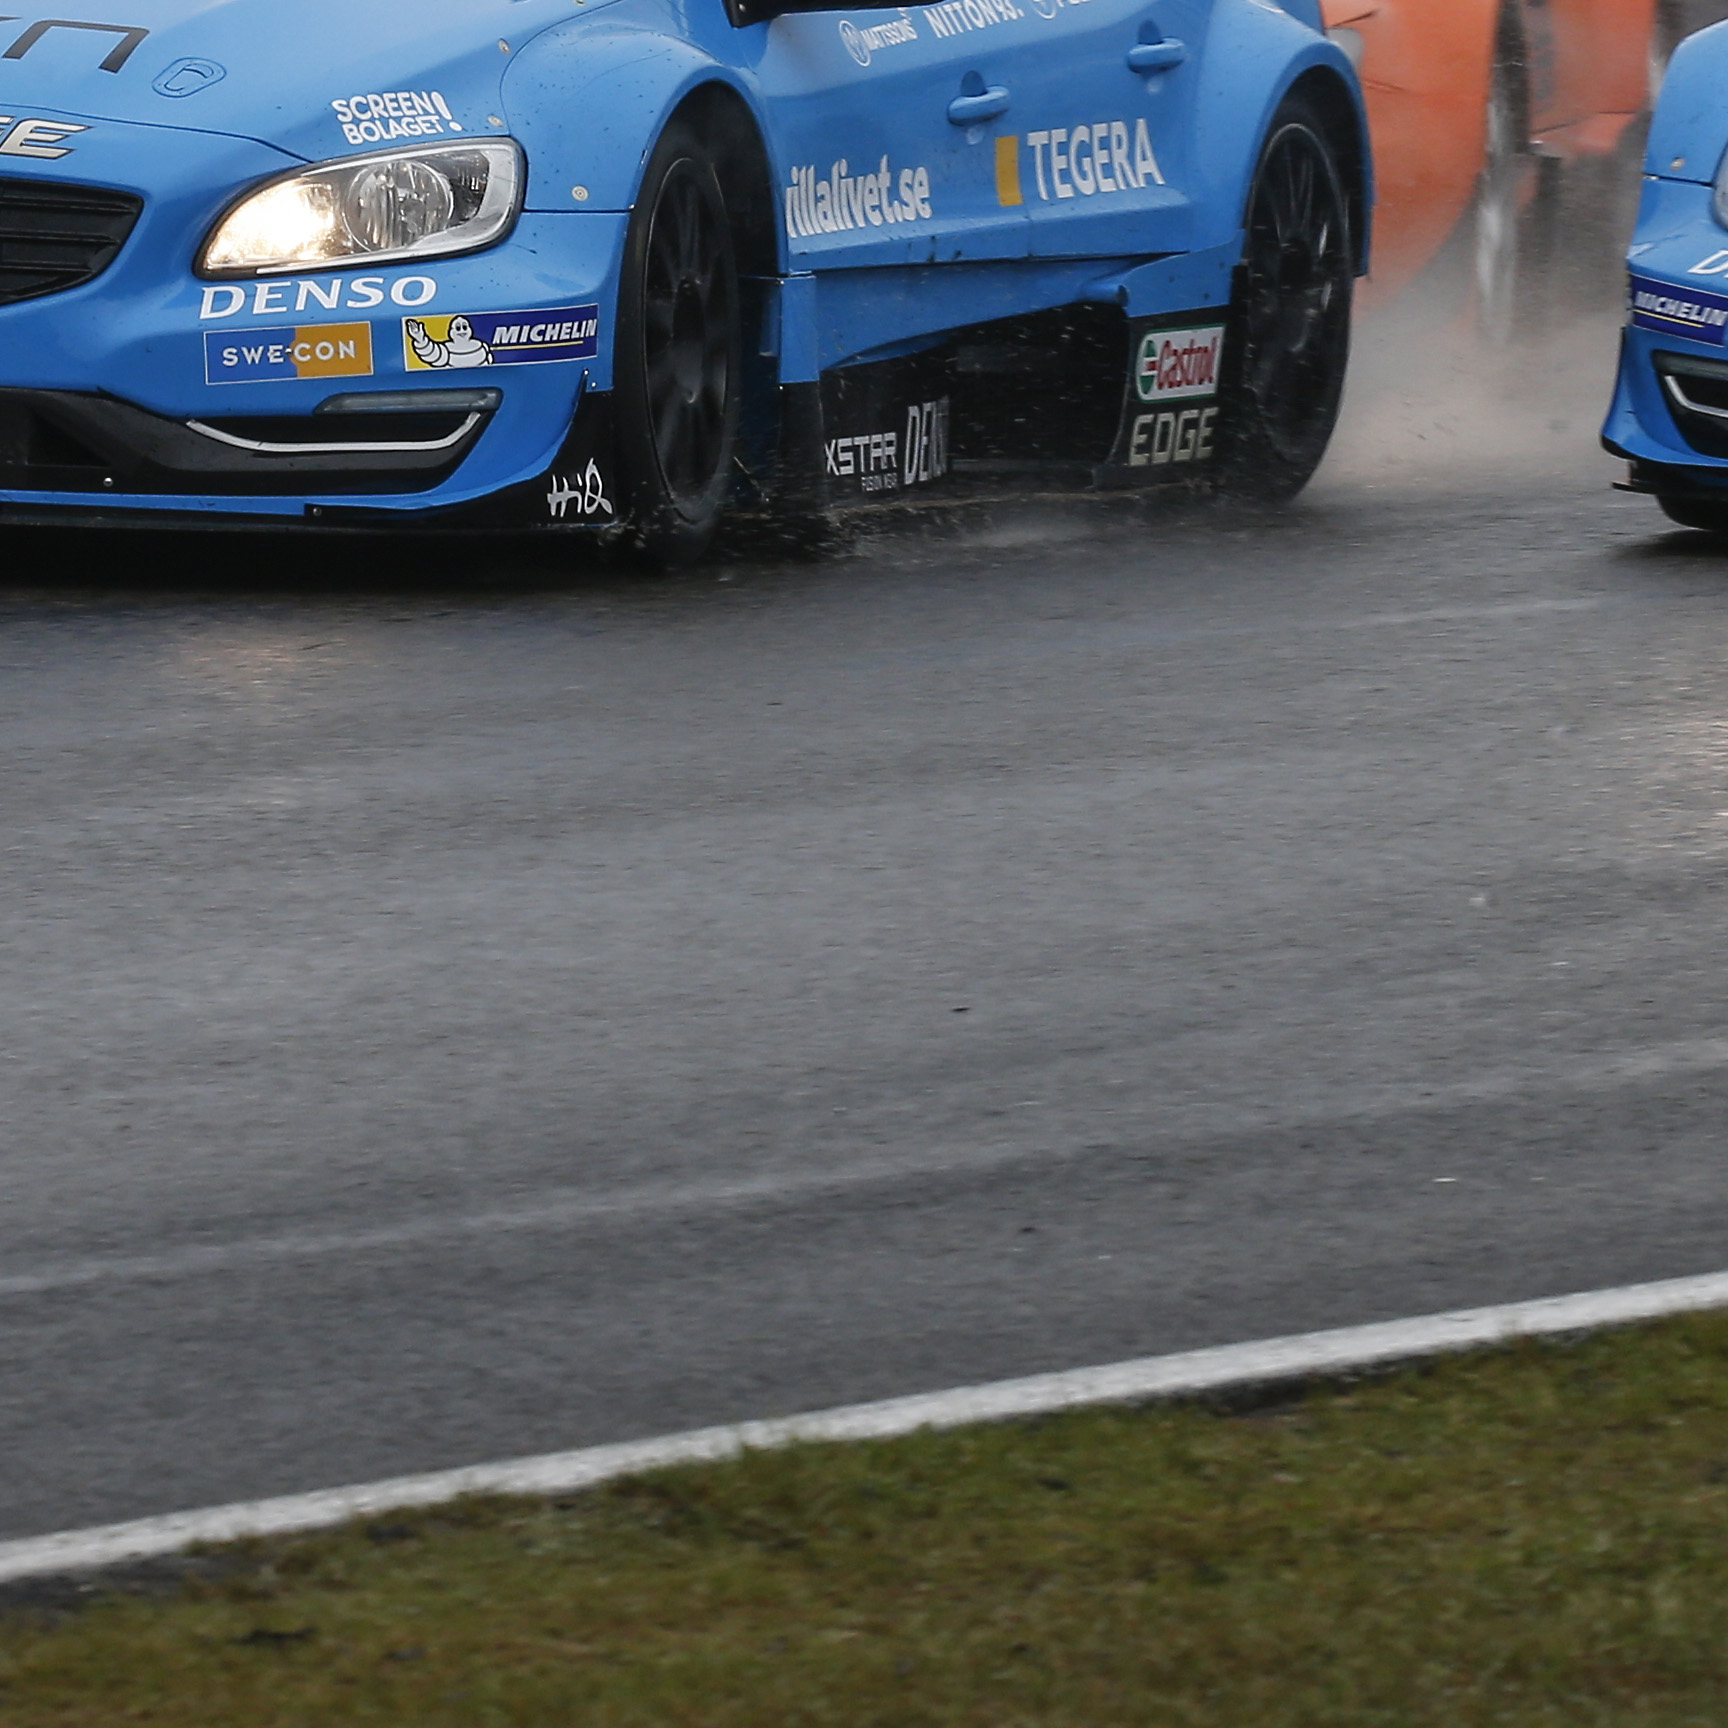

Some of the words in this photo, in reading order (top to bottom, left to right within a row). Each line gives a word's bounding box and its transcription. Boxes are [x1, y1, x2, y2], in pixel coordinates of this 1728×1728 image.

[1027, 117, 1166, 201] TEGERA
[199, 276, 437, 320] DENSO
[492, 317, 598, 346] MICHELIN
[1129, 406, 1220, 467] EDGE
